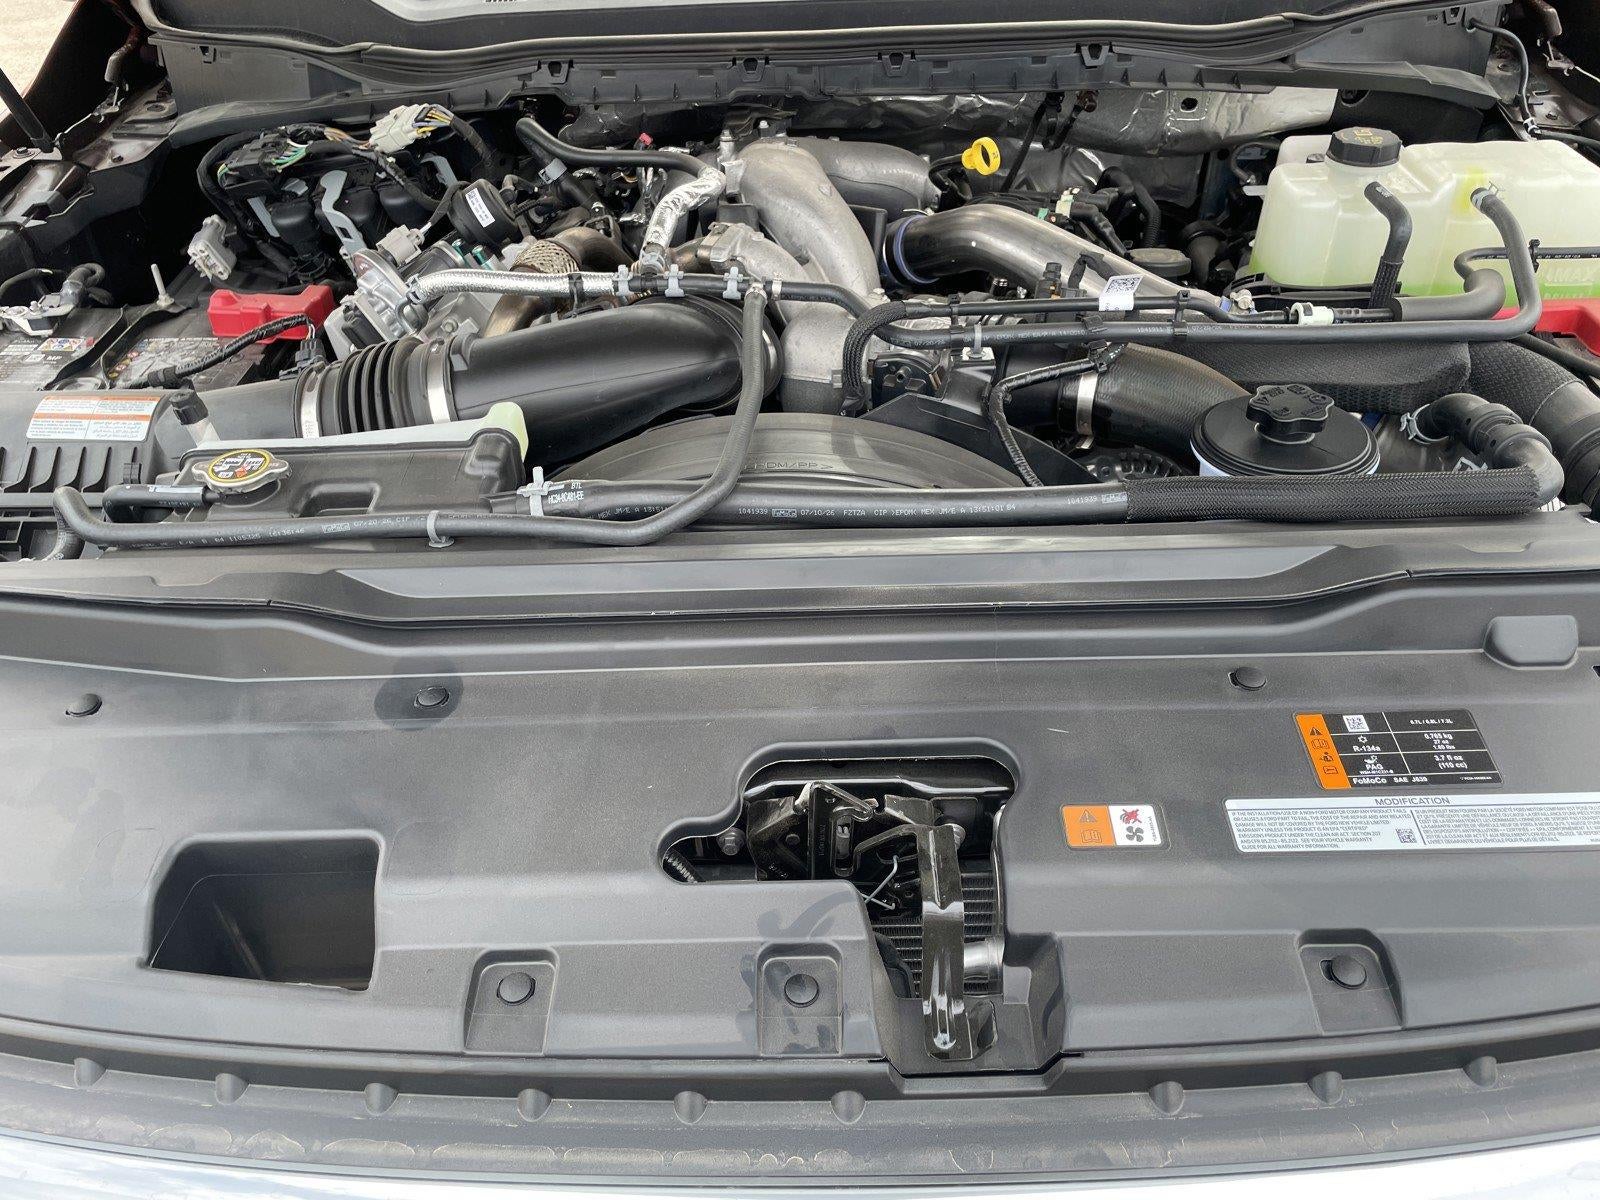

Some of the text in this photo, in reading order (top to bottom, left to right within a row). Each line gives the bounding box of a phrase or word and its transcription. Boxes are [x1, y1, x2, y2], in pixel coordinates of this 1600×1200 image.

[920, 507, 935, 515] MEX
[970, 504, 1004, 514] 13:51:01
[1455, 761, 1468, 769] cc)
[1374, 797, 1450, 806] MODIFICATION
